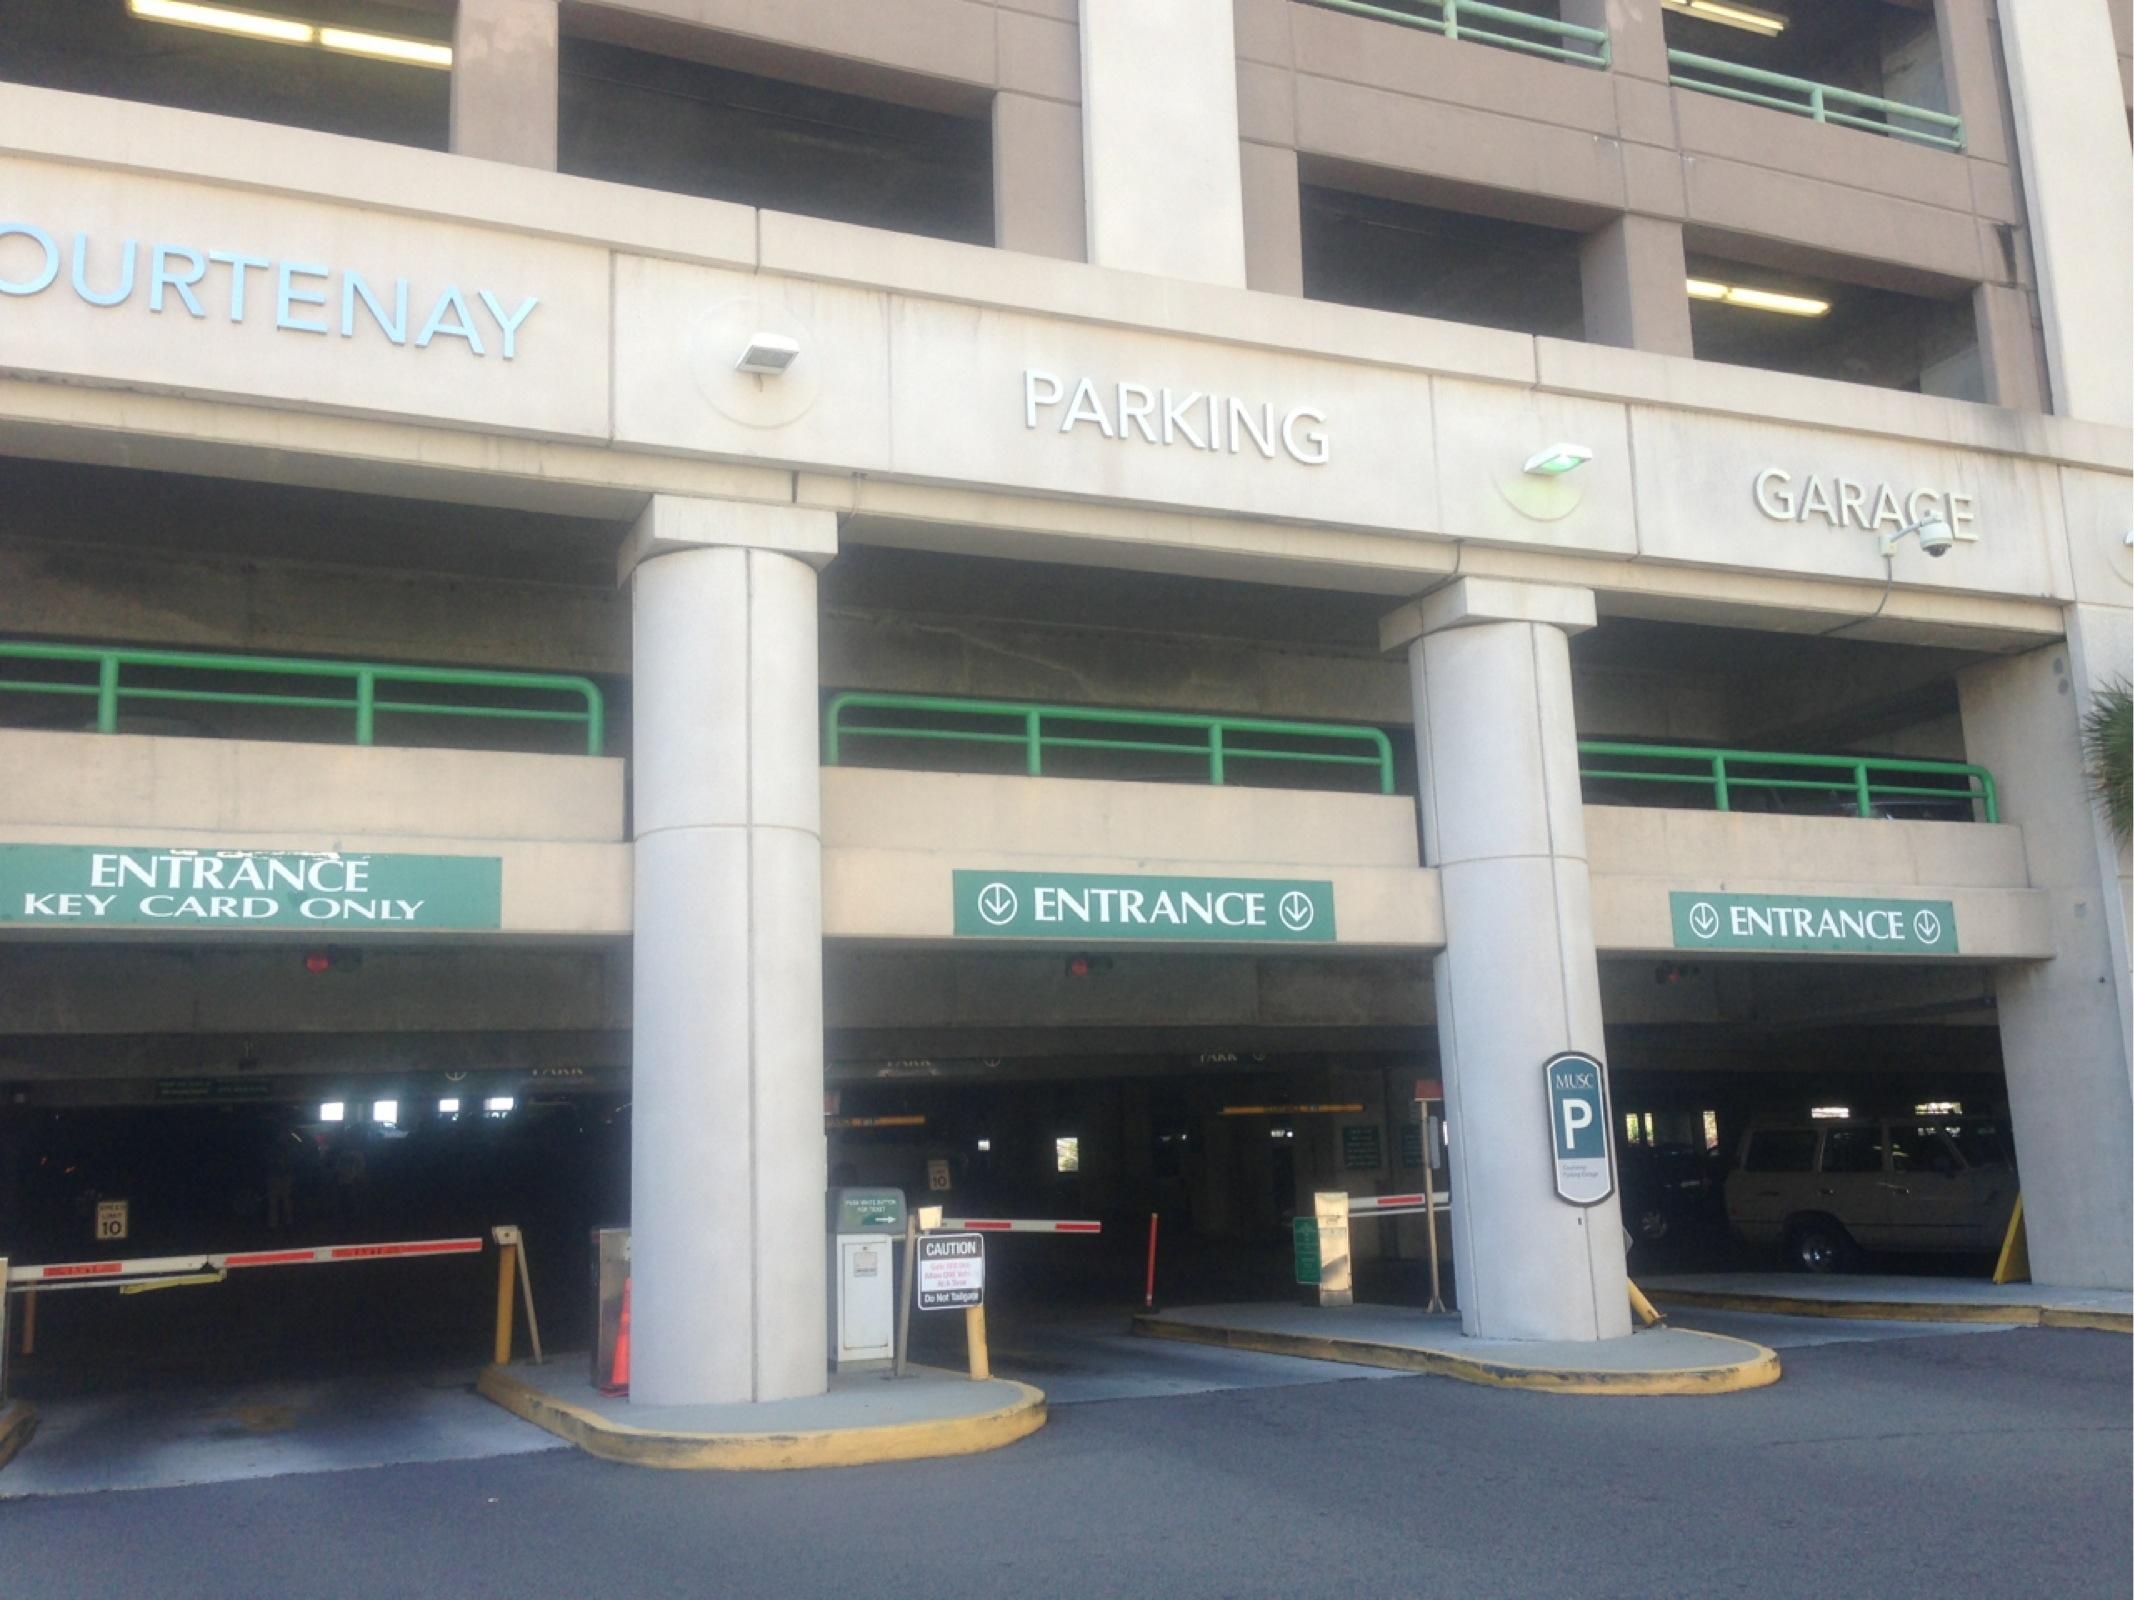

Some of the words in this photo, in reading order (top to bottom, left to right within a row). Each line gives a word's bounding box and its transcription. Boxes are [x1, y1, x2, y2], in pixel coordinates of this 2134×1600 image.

[1023, 369, 1330, 465] PARKING
[1753, 467, 1979, 543] GARAGE
[90, 853, 370, 893] ENTRANCE
[23, 893, 118, 916] KEY
[139, 895, 279, 918] CARD
[300, 898, 425, 921] ONLY
[1034, 887, 1267, 926] ENTRANCE
[1730, 906, 1906, 939] ENTRANCE
[1556, 1073, 1594, 1089] MUSC
[1562, 1098, 1593, 1149] P
[932, 1175, 946, 1188] 10
[102, 1220, 122, 1236] 10
[926, 1241, 976, 1256] CAUTION
[924, 1294, 934, 1303] Do
[936, 1293, 949, 1302] Not
